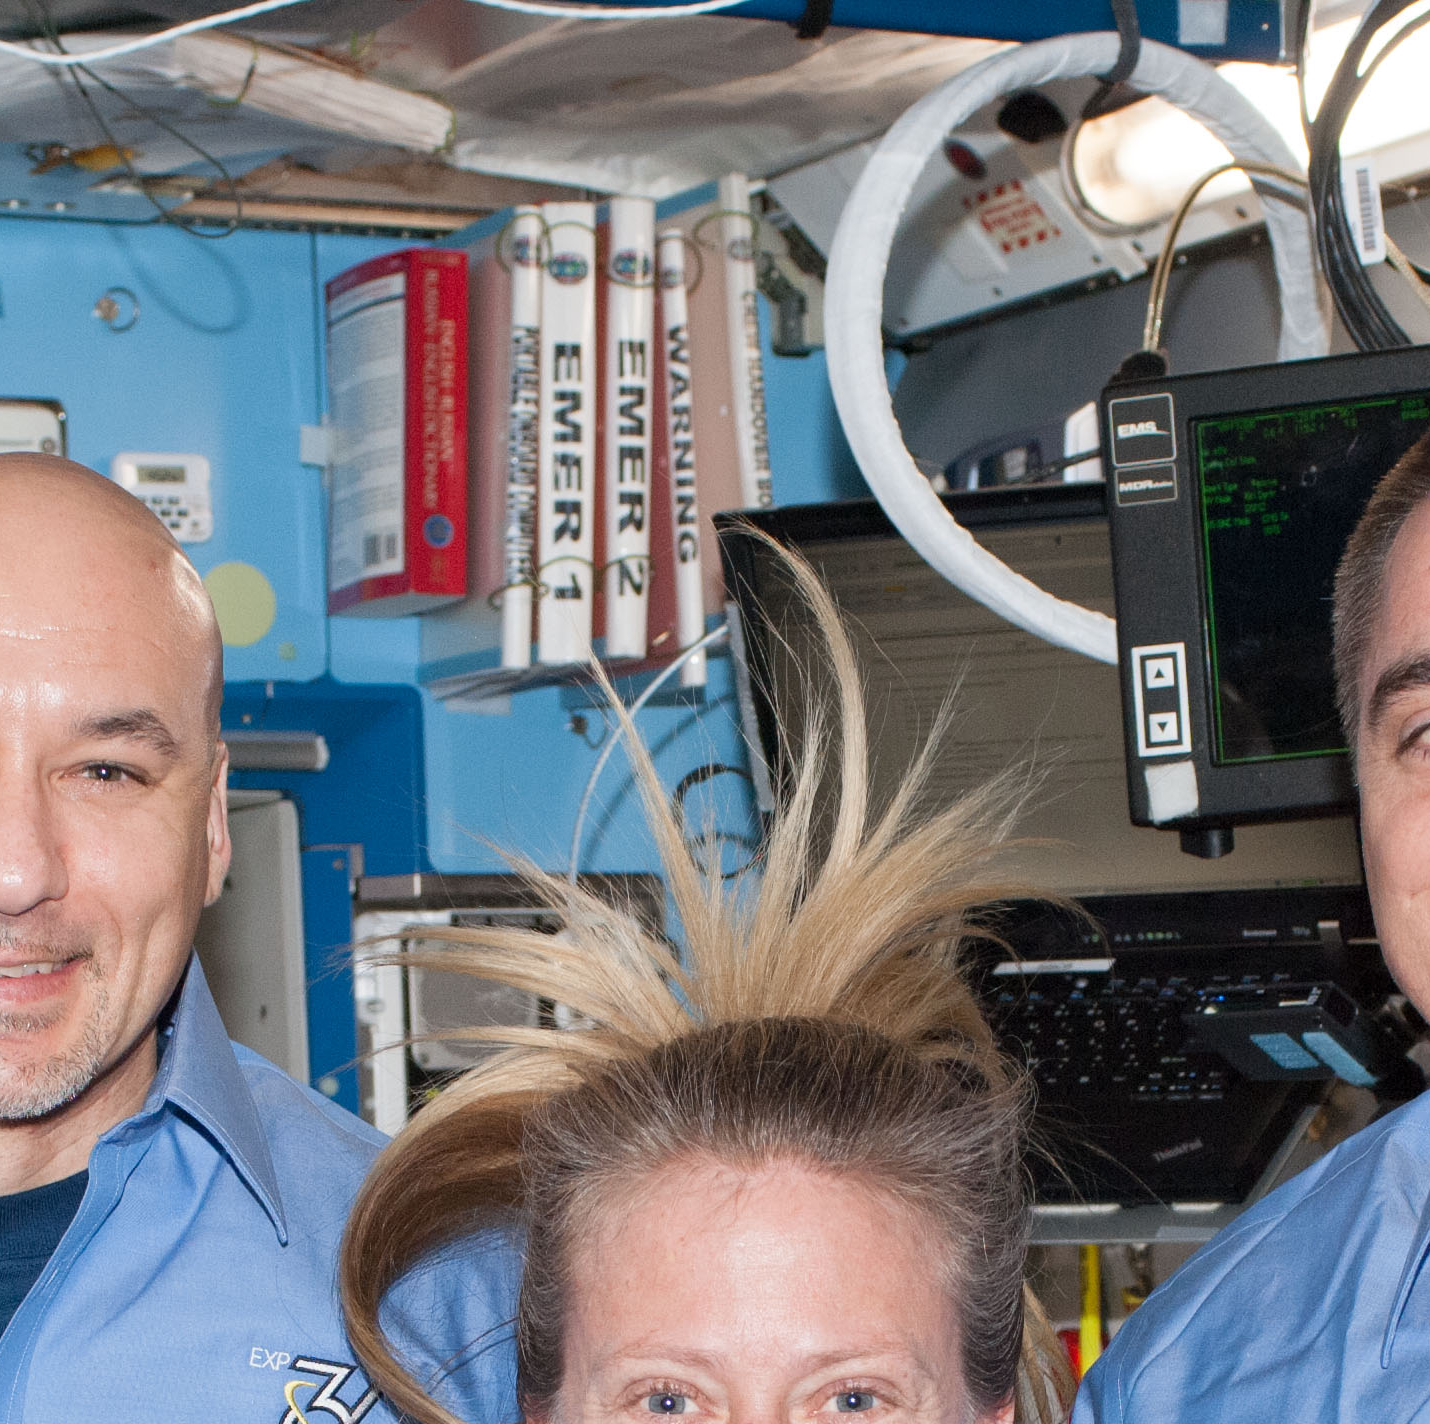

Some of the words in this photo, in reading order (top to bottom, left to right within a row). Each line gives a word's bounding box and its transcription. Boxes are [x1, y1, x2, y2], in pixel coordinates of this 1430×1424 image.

[554, 342, 582, 545] EMER
[618, 339, 647, 535] EMER
[666, 324, 699, 565] WARNING
[1117, 421, 1158, 438] EMS
[554, 572, 583, 601] 1
[618, 560, 645, 598] 2
[249, 1346, 291, 1372] EXP
